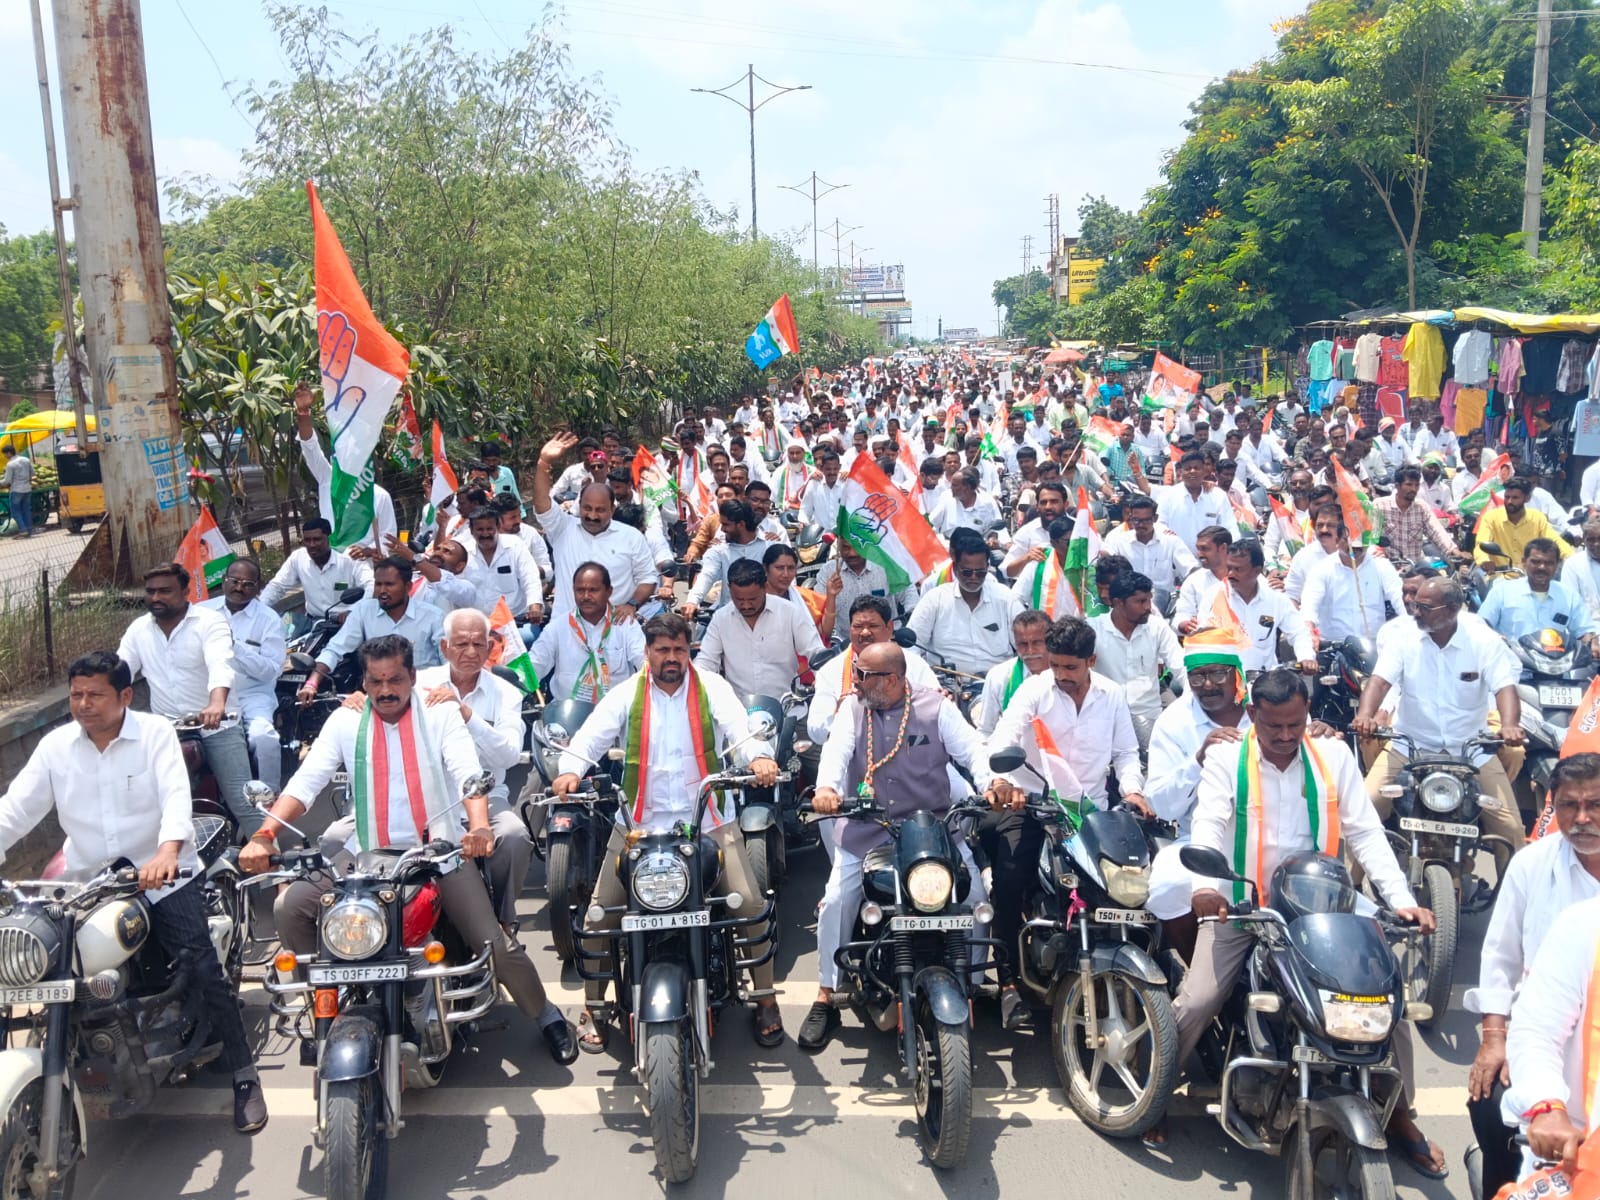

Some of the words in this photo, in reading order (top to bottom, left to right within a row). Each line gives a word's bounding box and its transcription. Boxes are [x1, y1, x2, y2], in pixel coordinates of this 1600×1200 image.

[634, 918, 647, 929] TG
[651, 917, 663, 928] 01
[671, 916, 677, 926] A
[682, 914, 708, 925] 8158
[903, 920, 916, 929] TG
[920, 920, 931, 929] 01
[937, 920, 943, 928] A
[323, 970, 337, 981] TS
[342, 968, 372, 980] 03FF
[377, 967, 406, 979] 2221
[37, 988, 69, 1000] 8189
